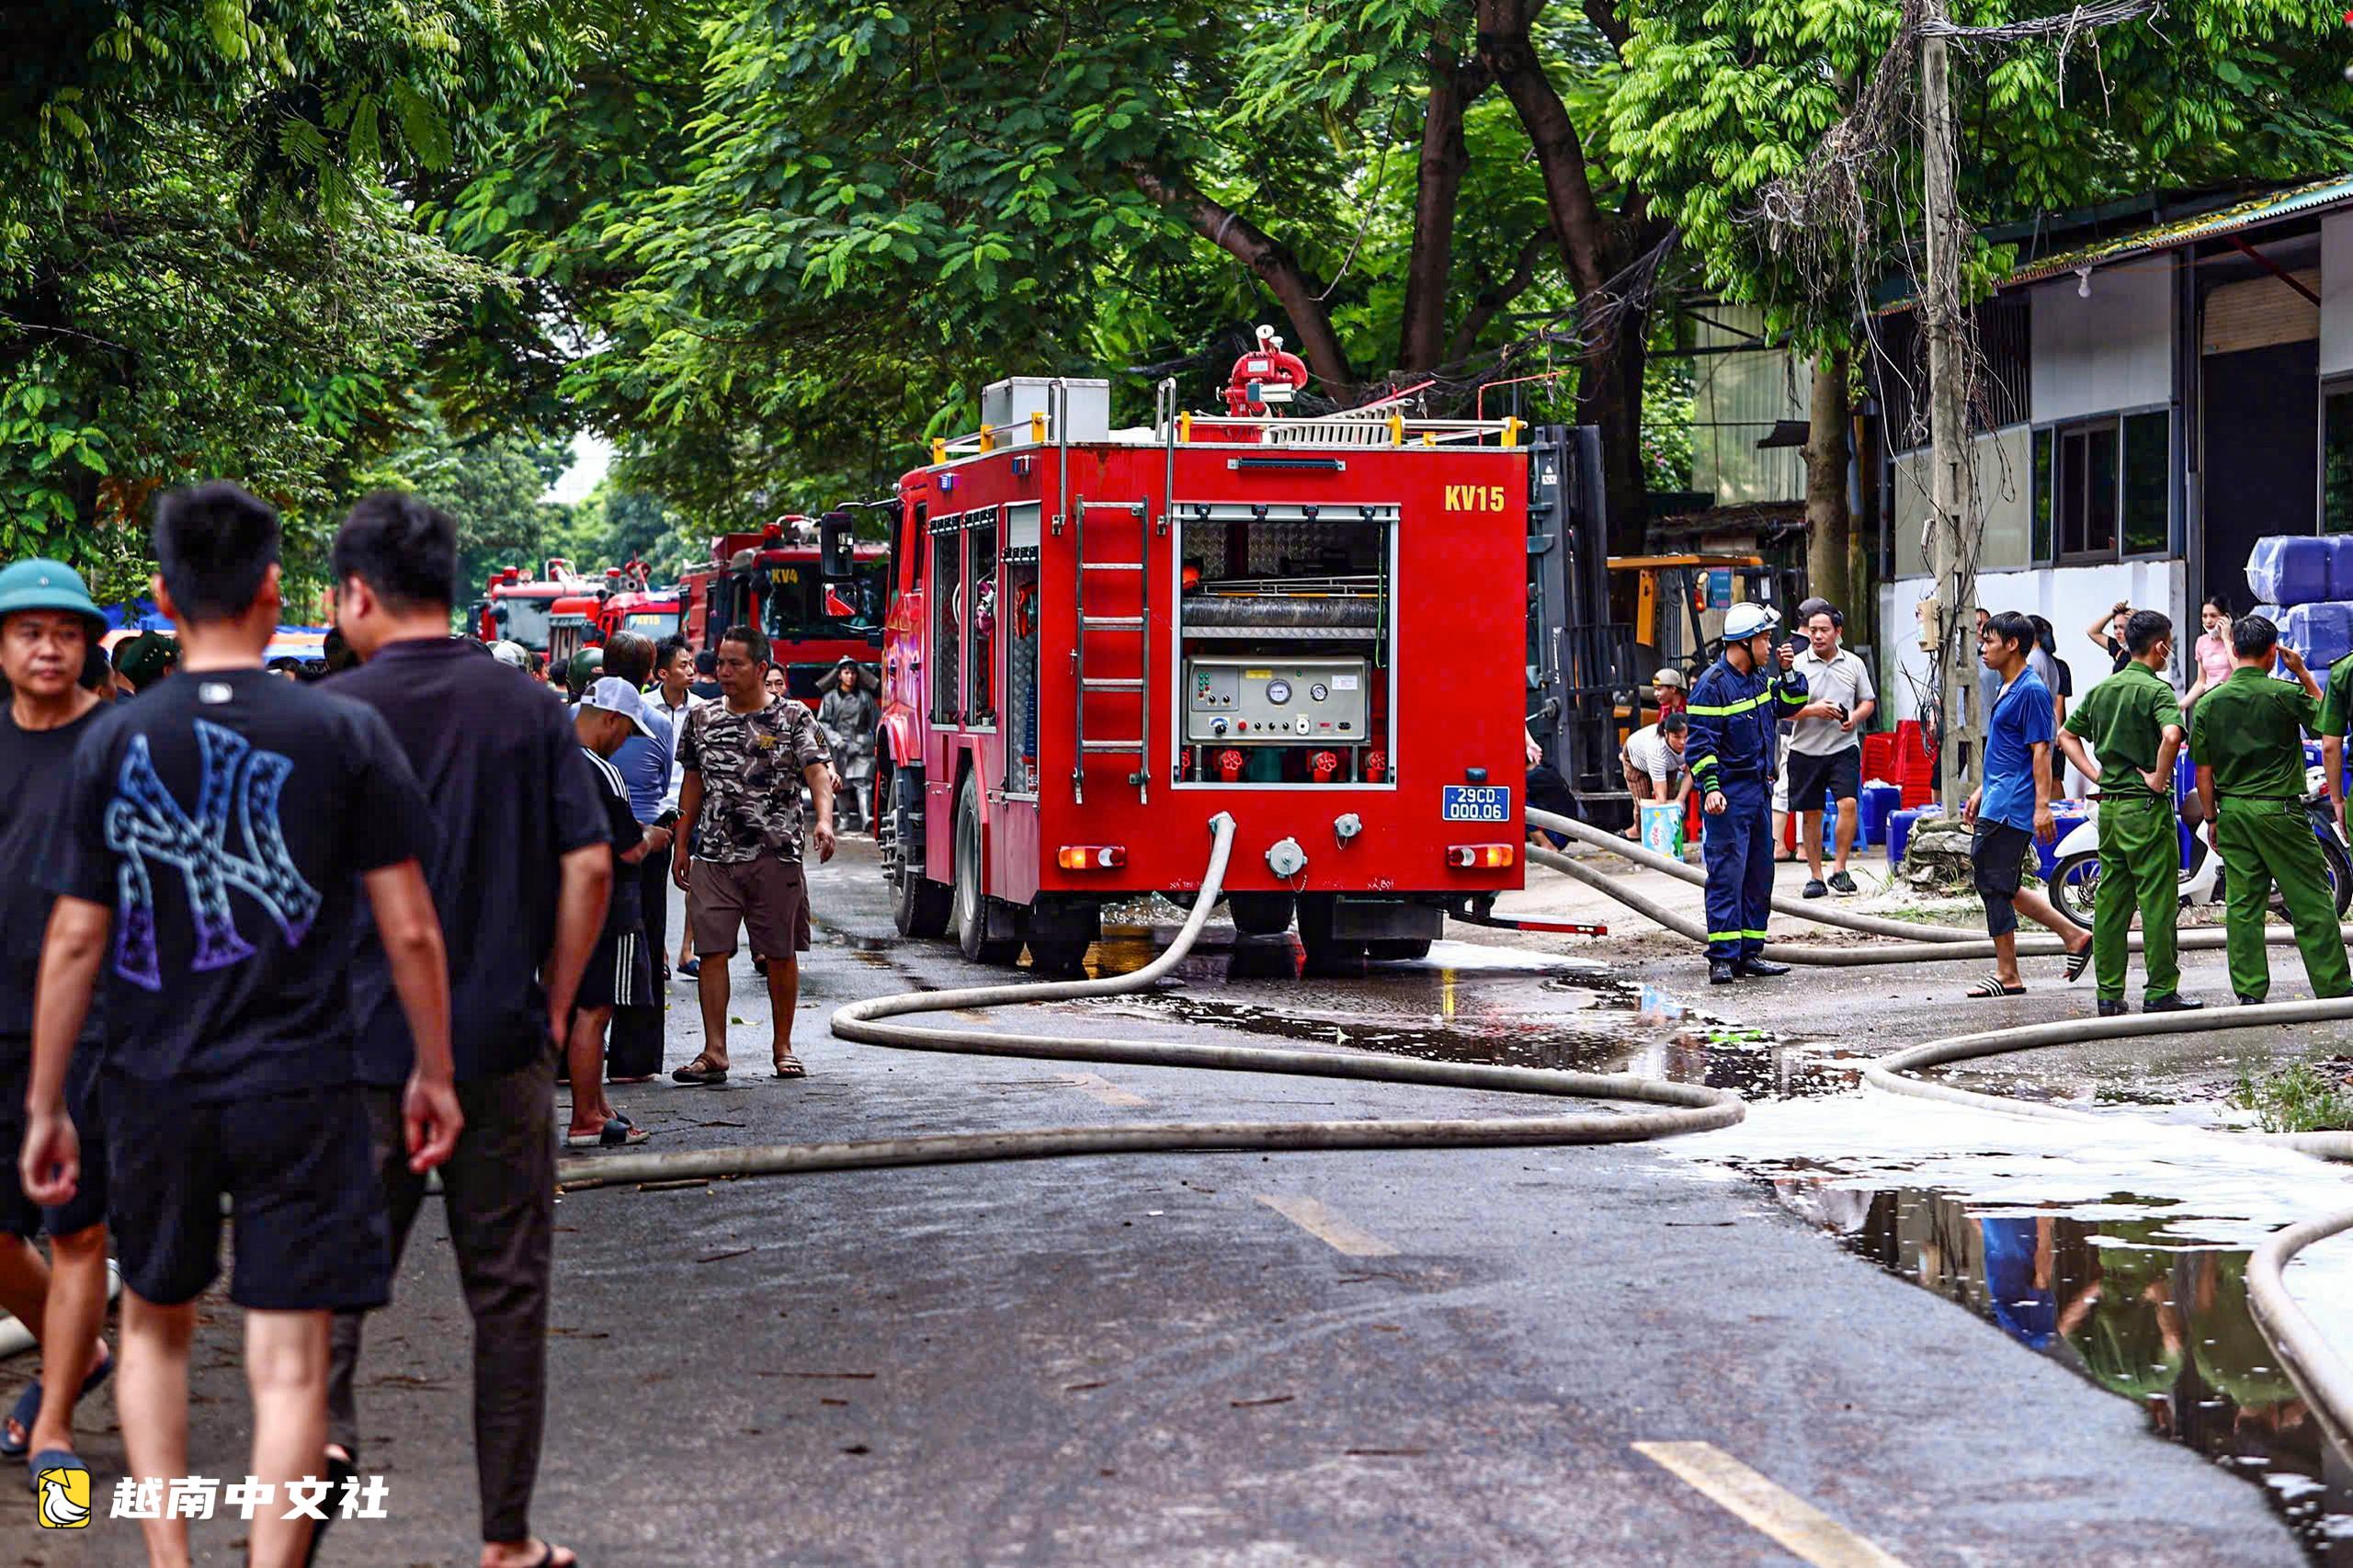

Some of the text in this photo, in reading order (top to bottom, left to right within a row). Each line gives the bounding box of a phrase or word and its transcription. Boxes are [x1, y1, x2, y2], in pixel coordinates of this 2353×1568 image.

[1445, 484, 1505, 512] KV15
[771, 568, 799, 584] KV4
[1457, 788, 1495, 803] 29CD
[1449, 803, 1502, 819] 000.06
